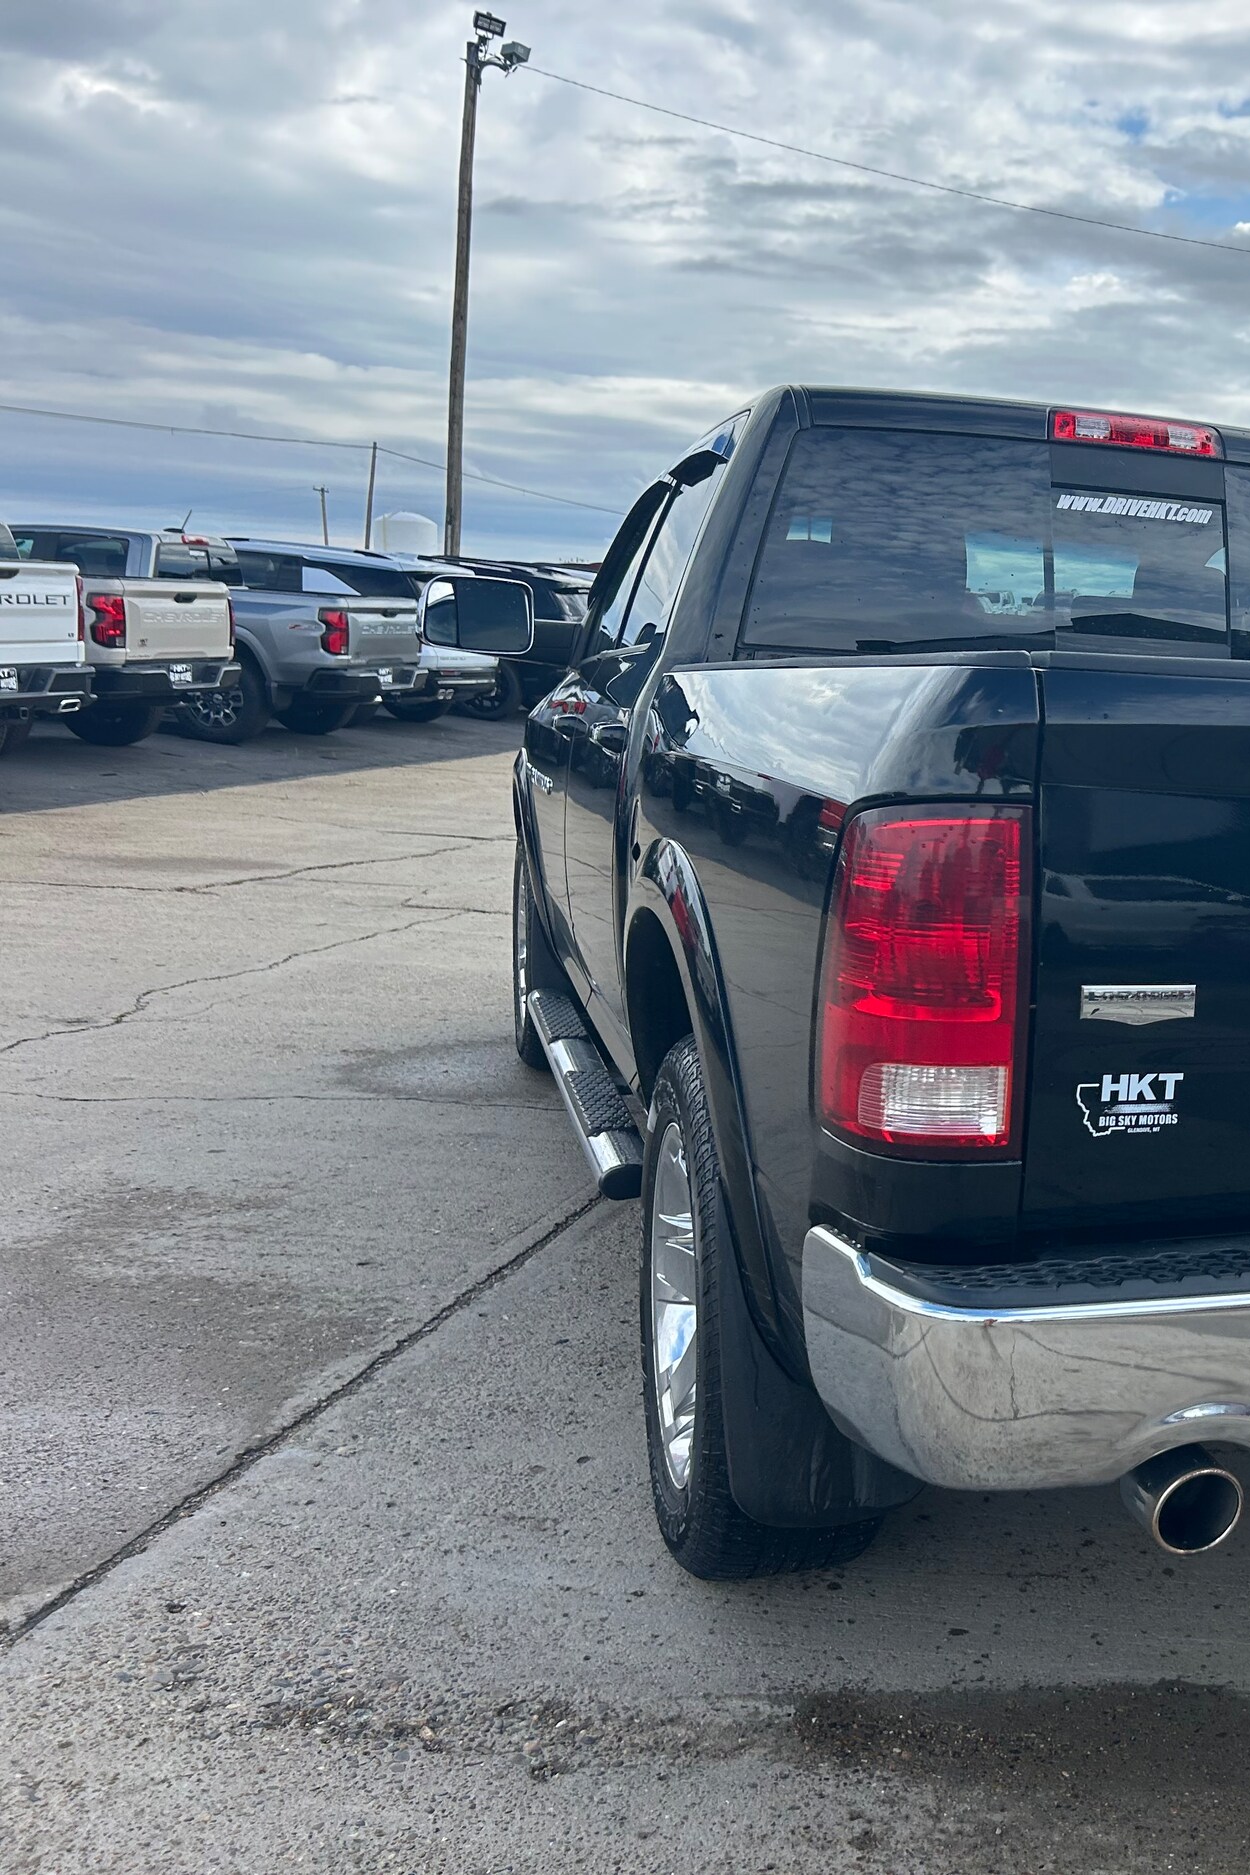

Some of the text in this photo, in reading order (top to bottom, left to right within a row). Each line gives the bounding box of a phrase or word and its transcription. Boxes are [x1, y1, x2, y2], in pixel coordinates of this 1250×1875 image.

[1100, 1072, 1184, 1102] HKT
[1098, 1113, 1179, 1127] BIG SKY MOTORS
